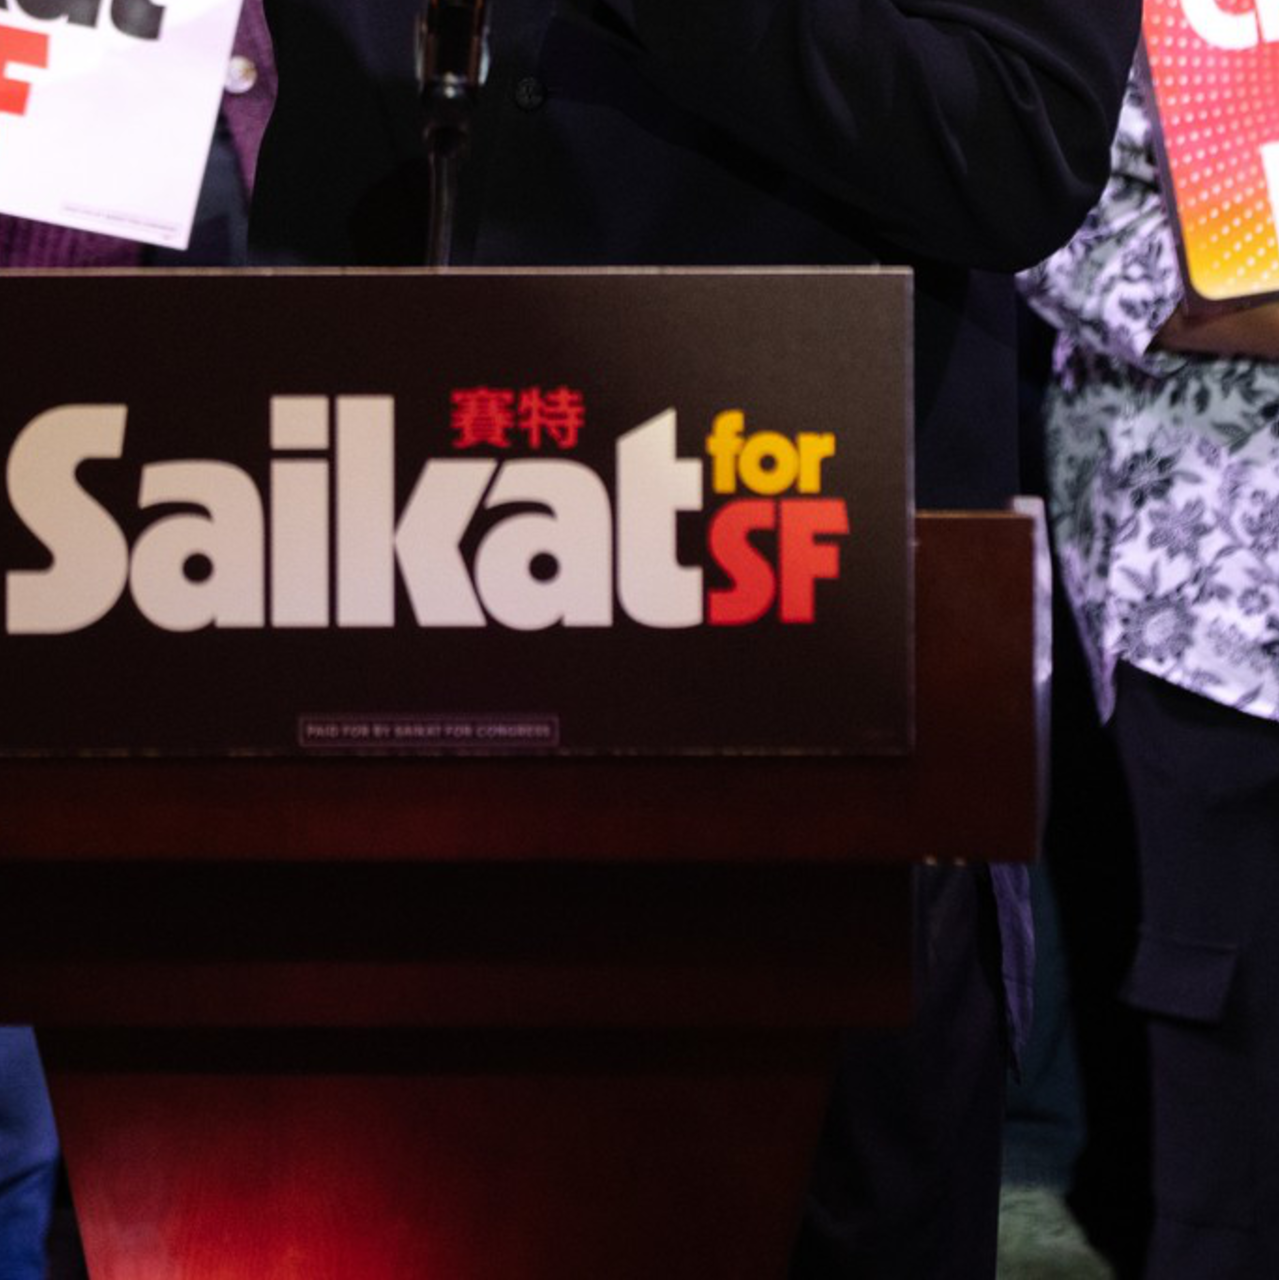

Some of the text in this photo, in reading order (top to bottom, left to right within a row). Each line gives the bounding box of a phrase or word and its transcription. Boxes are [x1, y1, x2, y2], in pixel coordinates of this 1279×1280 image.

[449, 385, 586, 450] 賽特
[705, 409, 837, 495] for
[4, 393, 704, 636] Saikat
[706, 497, 851, 627] SF
